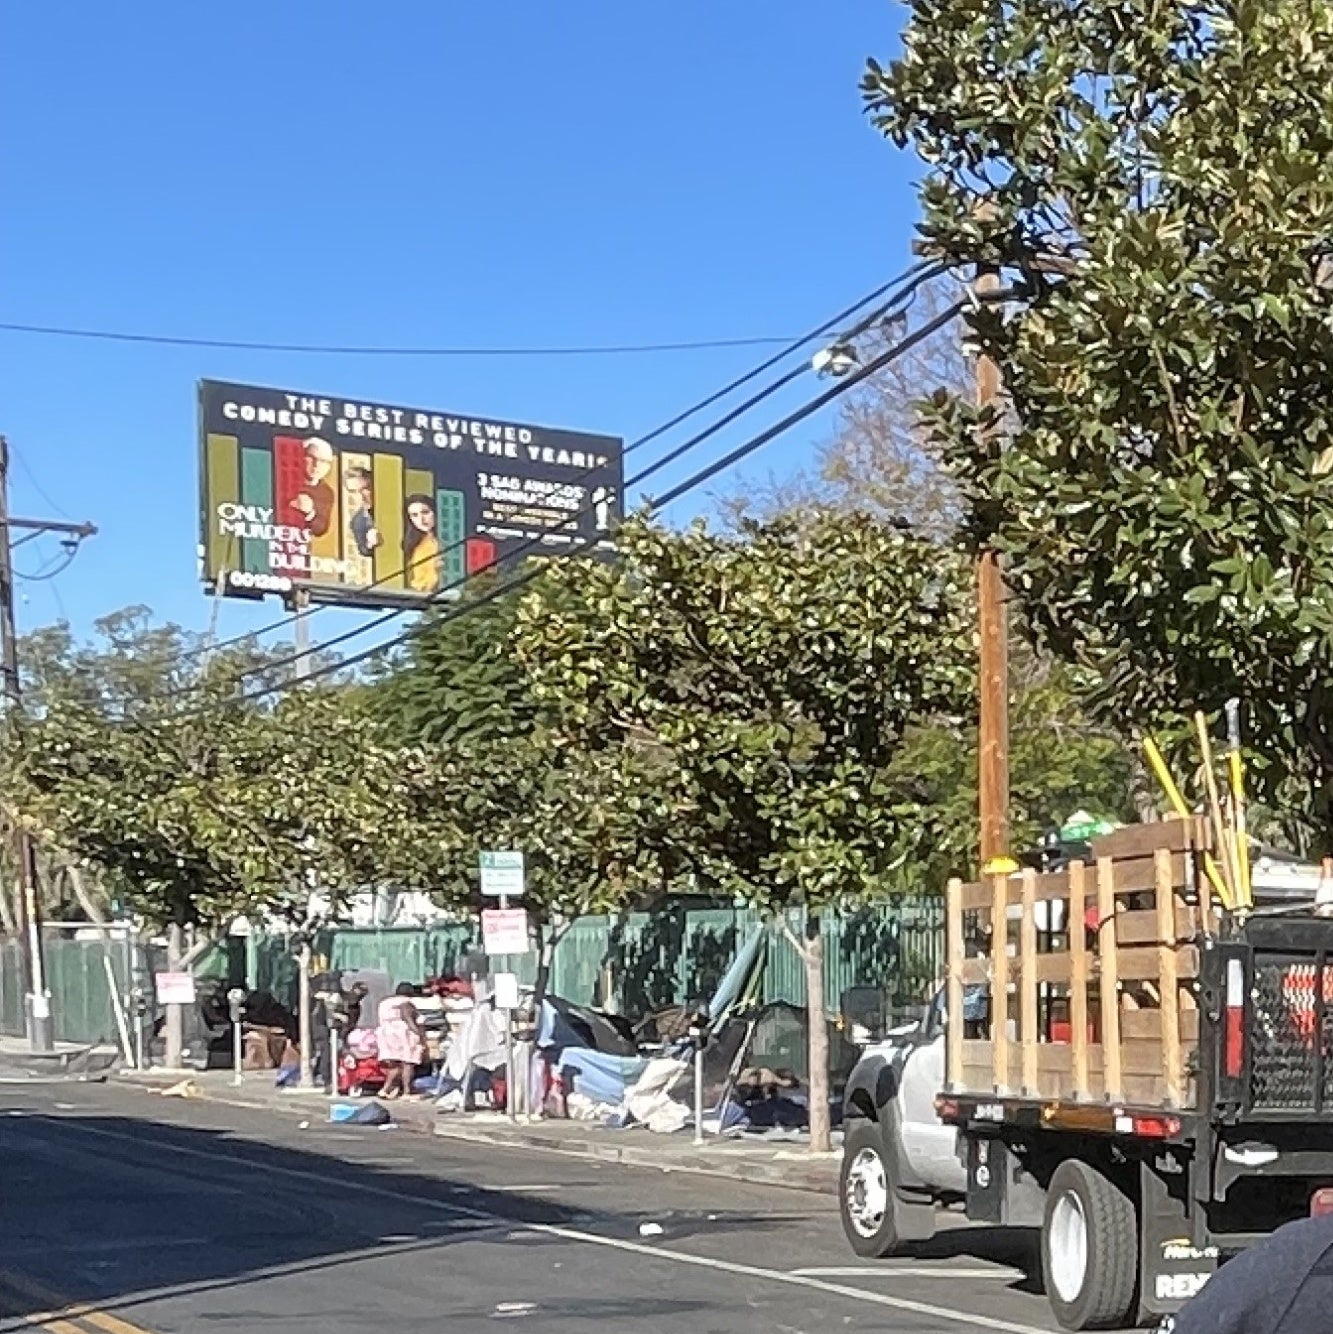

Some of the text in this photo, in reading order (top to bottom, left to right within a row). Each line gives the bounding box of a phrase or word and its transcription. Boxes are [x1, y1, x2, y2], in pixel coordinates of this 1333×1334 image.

[223, 402, 325, 431] COMEDY
[335, 418, 424, 445] SERIES
[433, 433, 463, 450] OF
[473, 438, 518, 458] THE
[284, 394, 532, 444] THE BEST REVIEWED
[217, 502, 273, 523] ONLY
